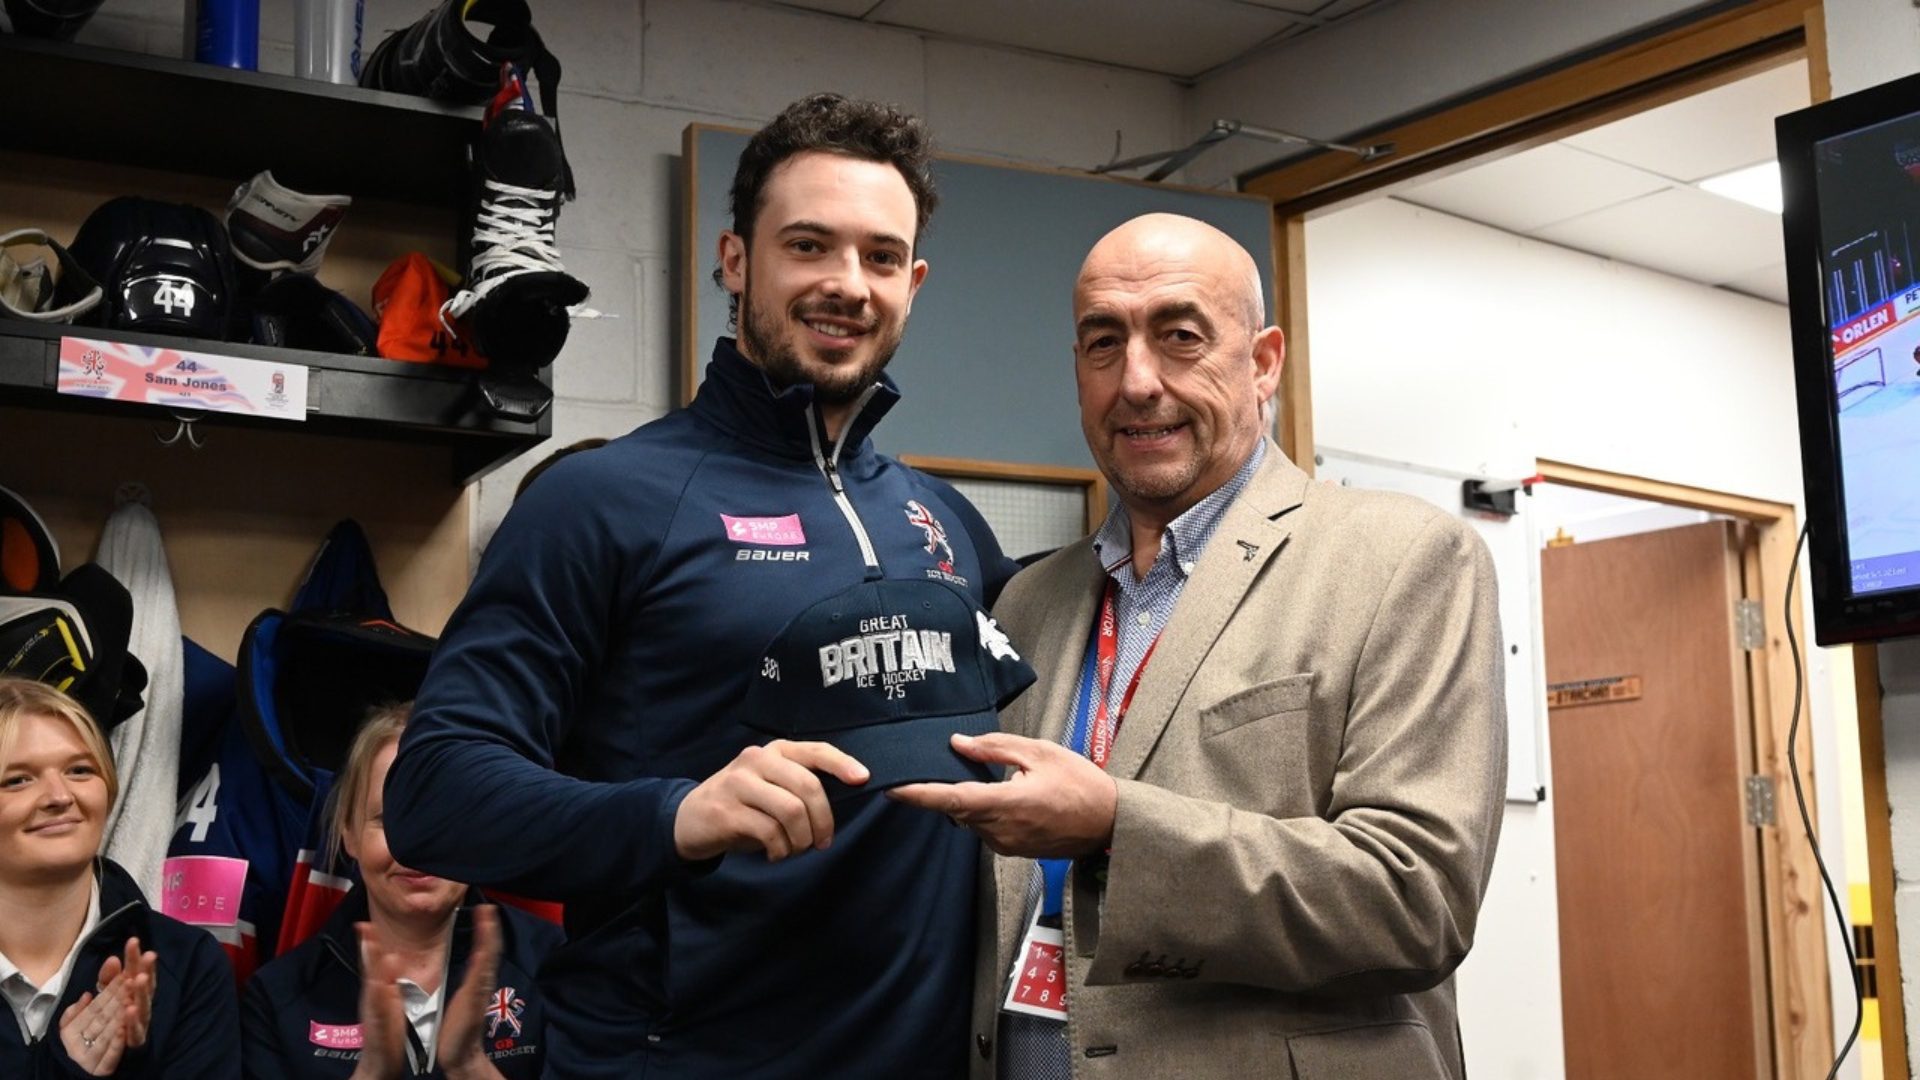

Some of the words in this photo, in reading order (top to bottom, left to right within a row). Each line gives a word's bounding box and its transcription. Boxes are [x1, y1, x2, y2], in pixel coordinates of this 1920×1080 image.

[153, 280, 195, 317] 44
[1905, 287, 1920, 304] PE
[1842, 308, 1888, 343] ORLEN
[175, 359, 198, 372] 44
[145, 372, 177, 387] Sam
[182, 377, 227, 393] Jones
[748, 521, 778, 532] SMP
[859, 614, 909, 633] GREAT
[818, 628, 957, 689] BRITAIN
[857, 674, 876, 688] ICE
[882, 669, 928, 687] HOCKEY
[884, 685, 906, 700] 75
[1093, 718, 1107, 763] VISITOR
[1053, 950, 1063, 964] 2
[1027, 966, 1038, 980] 4
[1047, 970, 1057, 983] 5
[1020, 985, 1032, 999] 7
[1040, 989, 1050, 1003] 8
[332, 1028, 359, 1038] SMP
[494, 1045, 537, 1059] HOCKEY
